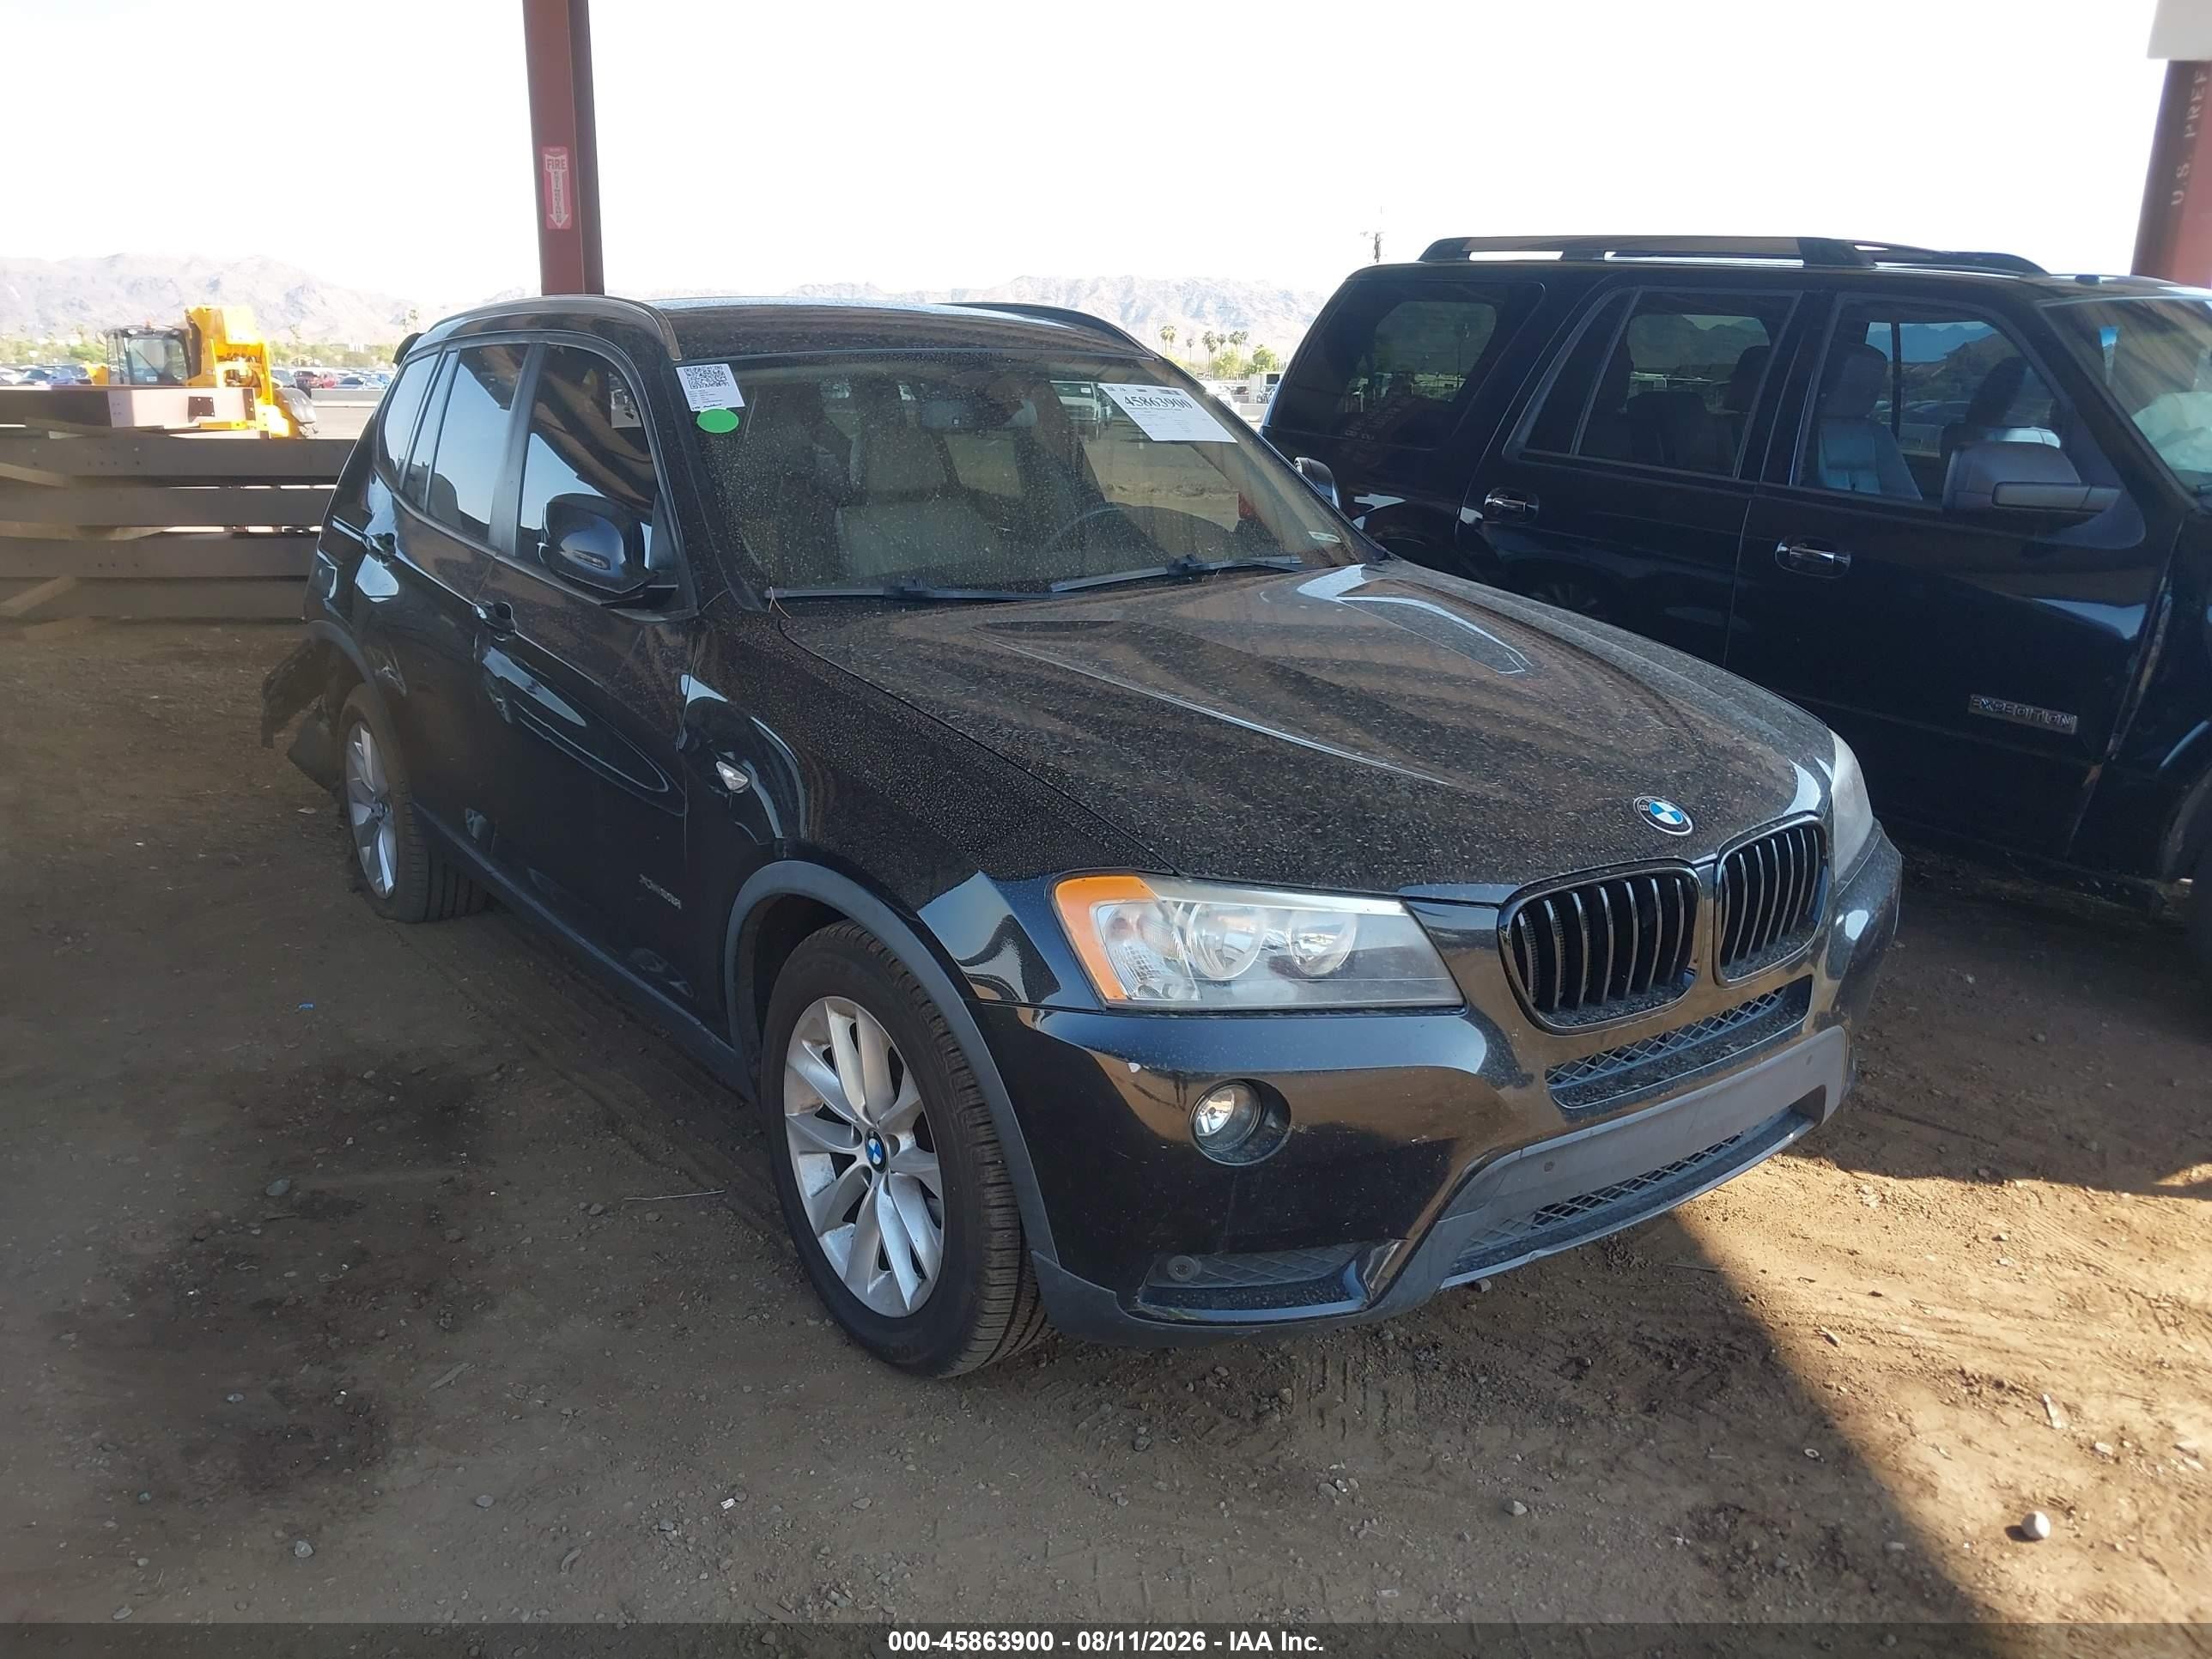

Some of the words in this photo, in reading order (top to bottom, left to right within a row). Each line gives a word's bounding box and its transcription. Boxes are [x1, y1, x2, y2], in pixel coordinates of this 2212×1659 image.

[546, 158, 567, 170] FIRE
[1124, 396, 1193, 409] 45863900
[1972, 697, 2075, 727] EXPEDITION
